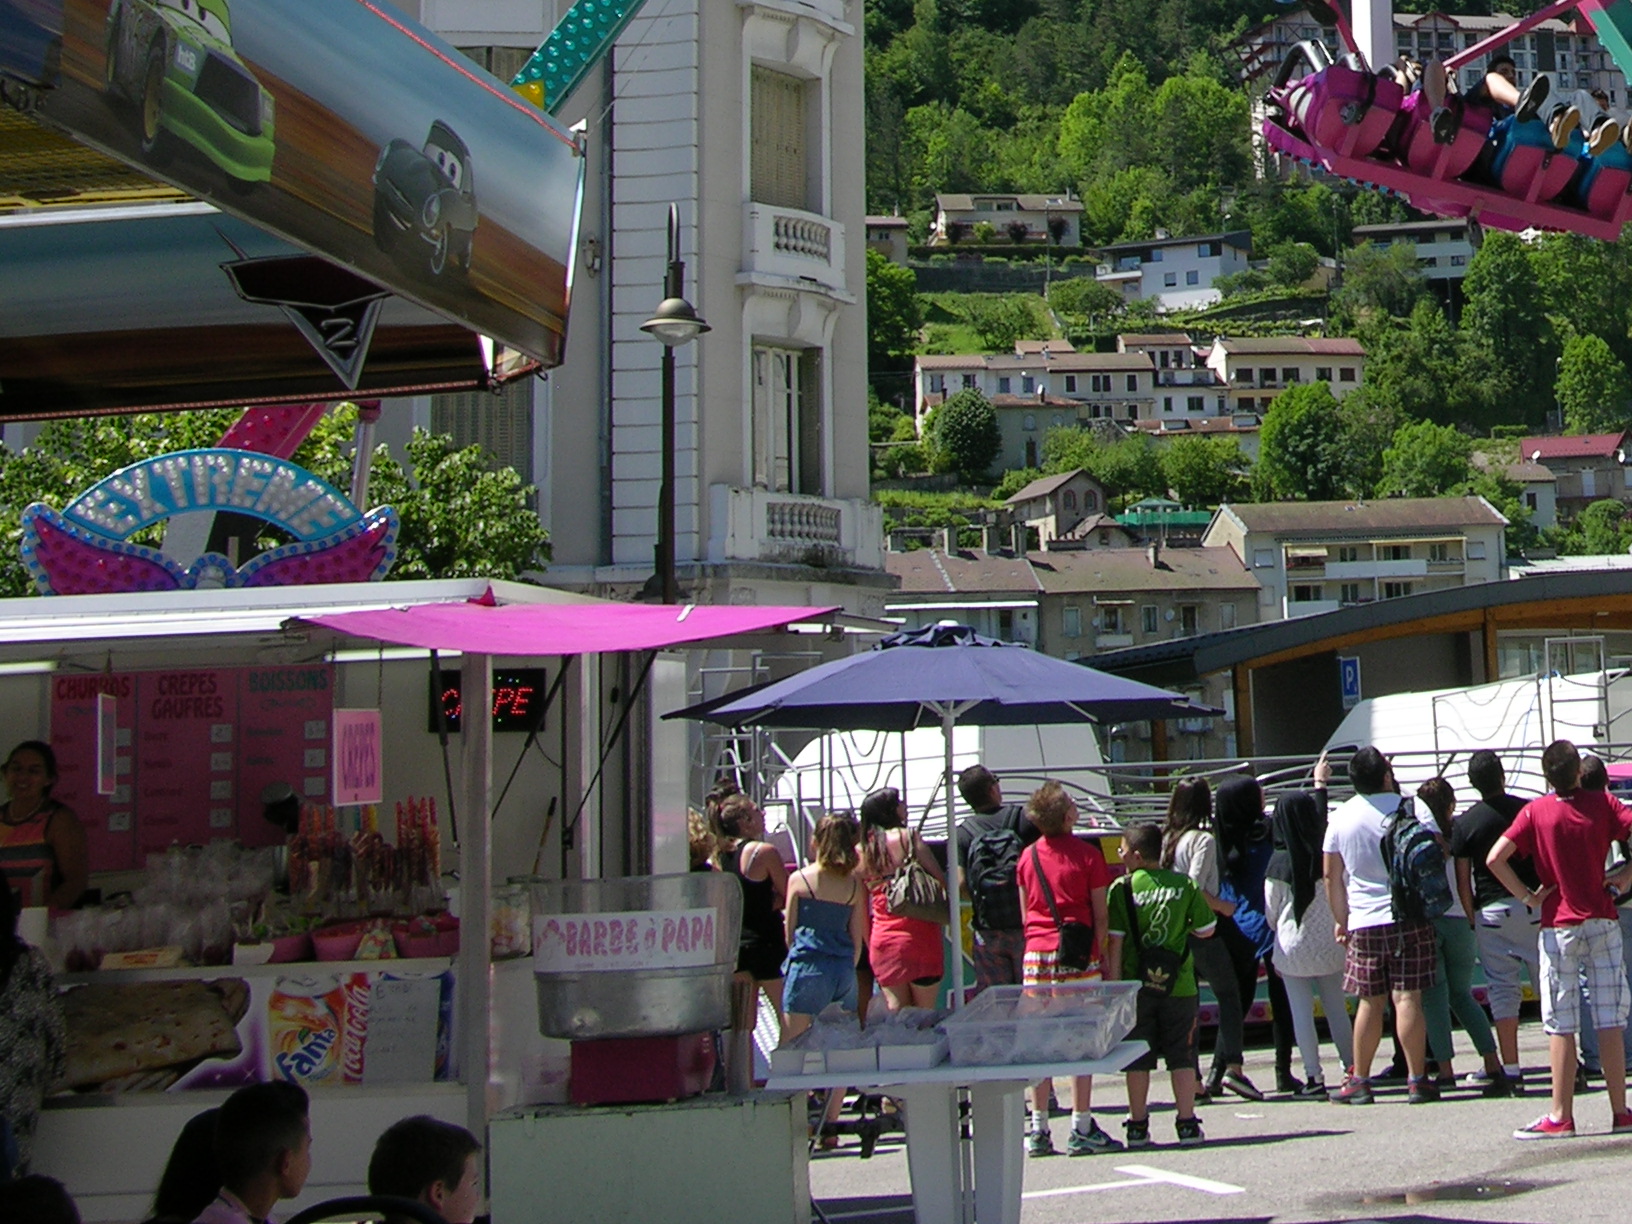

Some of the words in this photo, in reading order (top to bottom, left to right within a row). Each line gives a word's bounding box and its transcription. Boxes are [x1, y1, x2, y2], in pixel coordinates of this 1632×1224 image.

[74, 455, 354, 536] EXTREME
[250, 669, 329, 693] BOISSONS
[1345, 665, 1355, 690] P
[152, 696, 223, 720] GAUFRES
[565, 918, 639, 957] BARBE
[661, 913, 714, 954] PAPA
